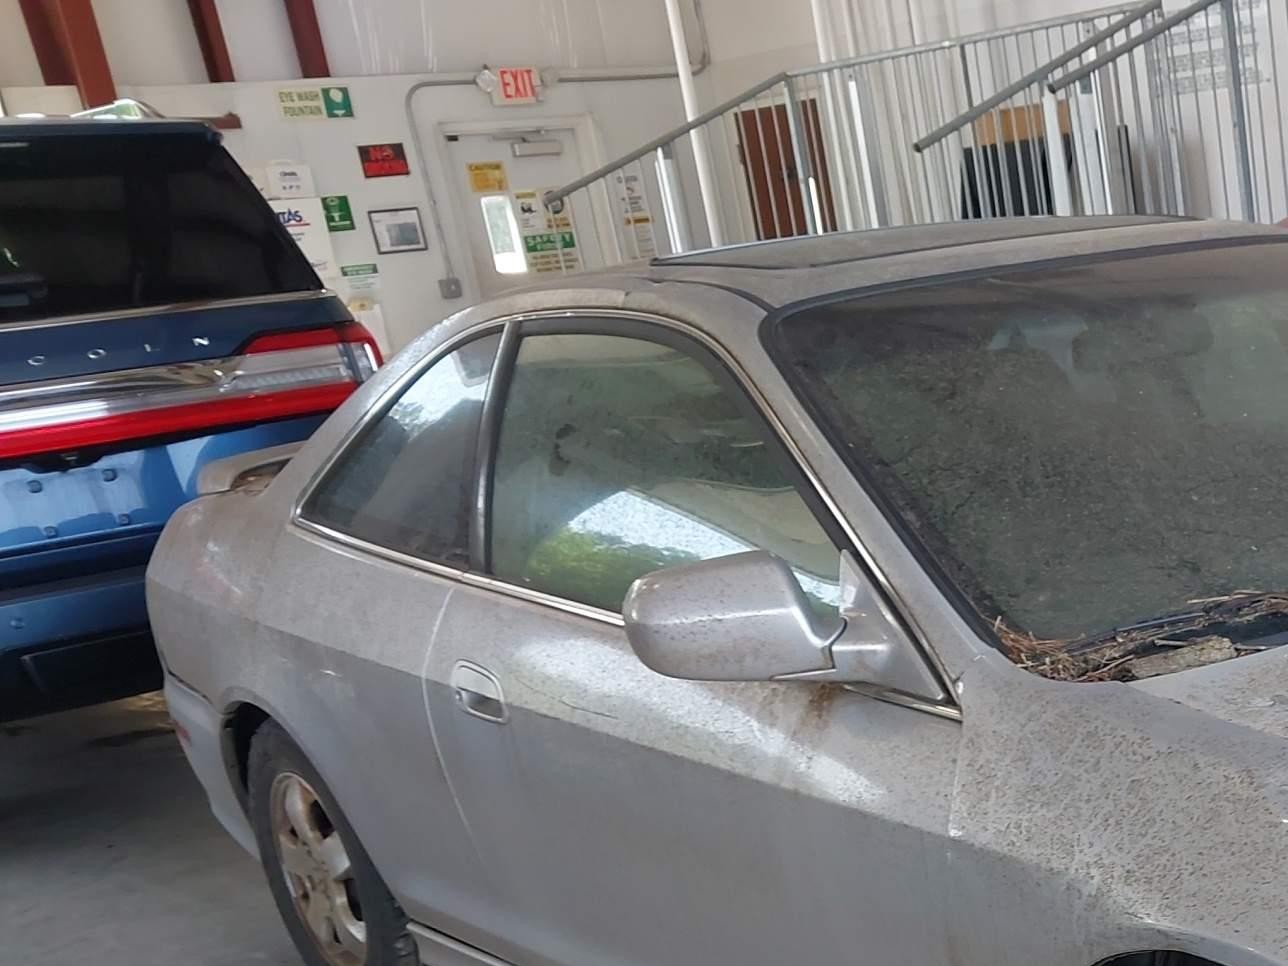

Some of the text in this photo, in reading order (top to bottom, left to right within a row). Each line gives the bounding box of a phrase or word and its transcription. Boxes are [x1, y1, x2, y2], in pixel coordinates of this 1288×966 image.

[500, 69, 536, 98] EXIT
[278, 90, 320, 103] EYE WASH
[282, 104, 322, 117] FOUNTAIN
